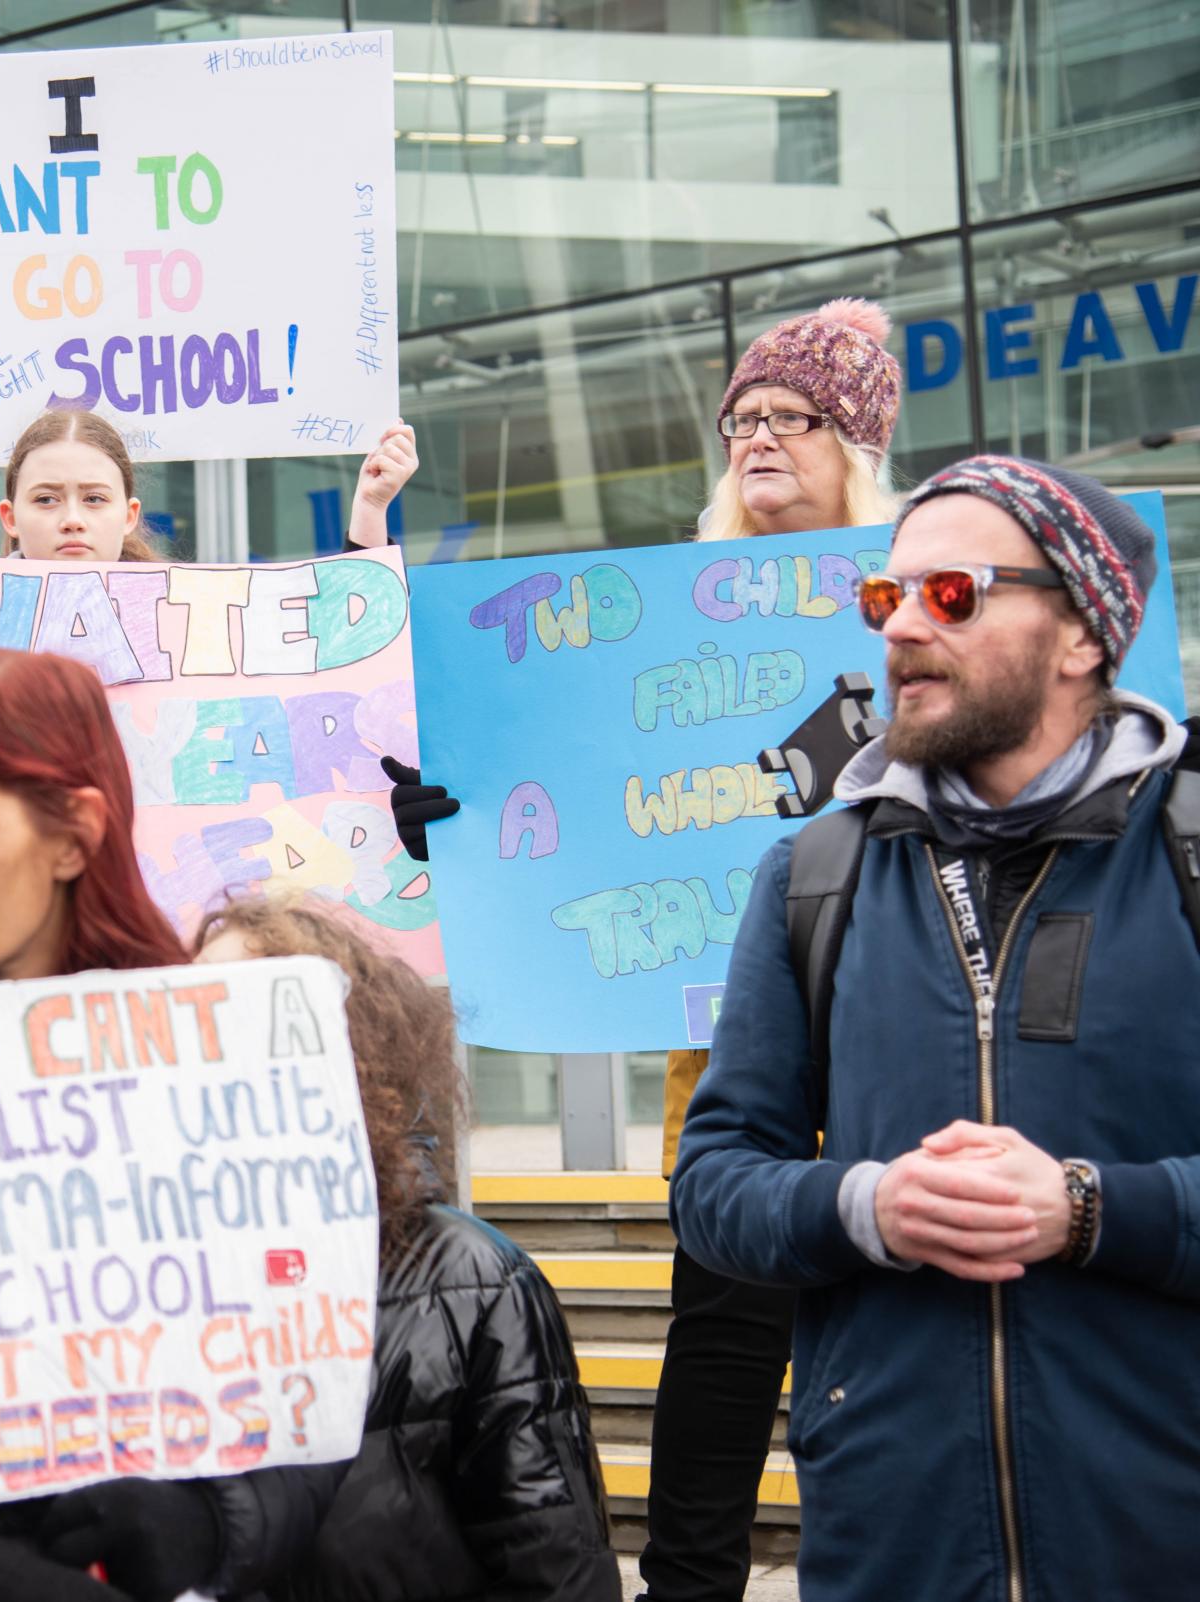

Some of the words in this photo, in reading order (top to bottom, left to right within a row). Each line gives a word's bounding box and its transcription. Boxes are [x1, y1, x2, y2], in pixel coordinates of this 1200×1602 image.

[47, 76, 99, 154] I
[137, 151, 223, 231] TO
[12, 254, 104, 321] GO
[124, 249, 203, 319] TO
[291, 412, 366, 446] #SEN
[468, 563, 643, 664] TWO
[499, 780, 559, 859] A
[551, 866, 758, 979] TRAU
[940, 859, 980, 944] WHERE
[269, 977, 325, 1058] A
[63, 1321, 163, 1390] MY
